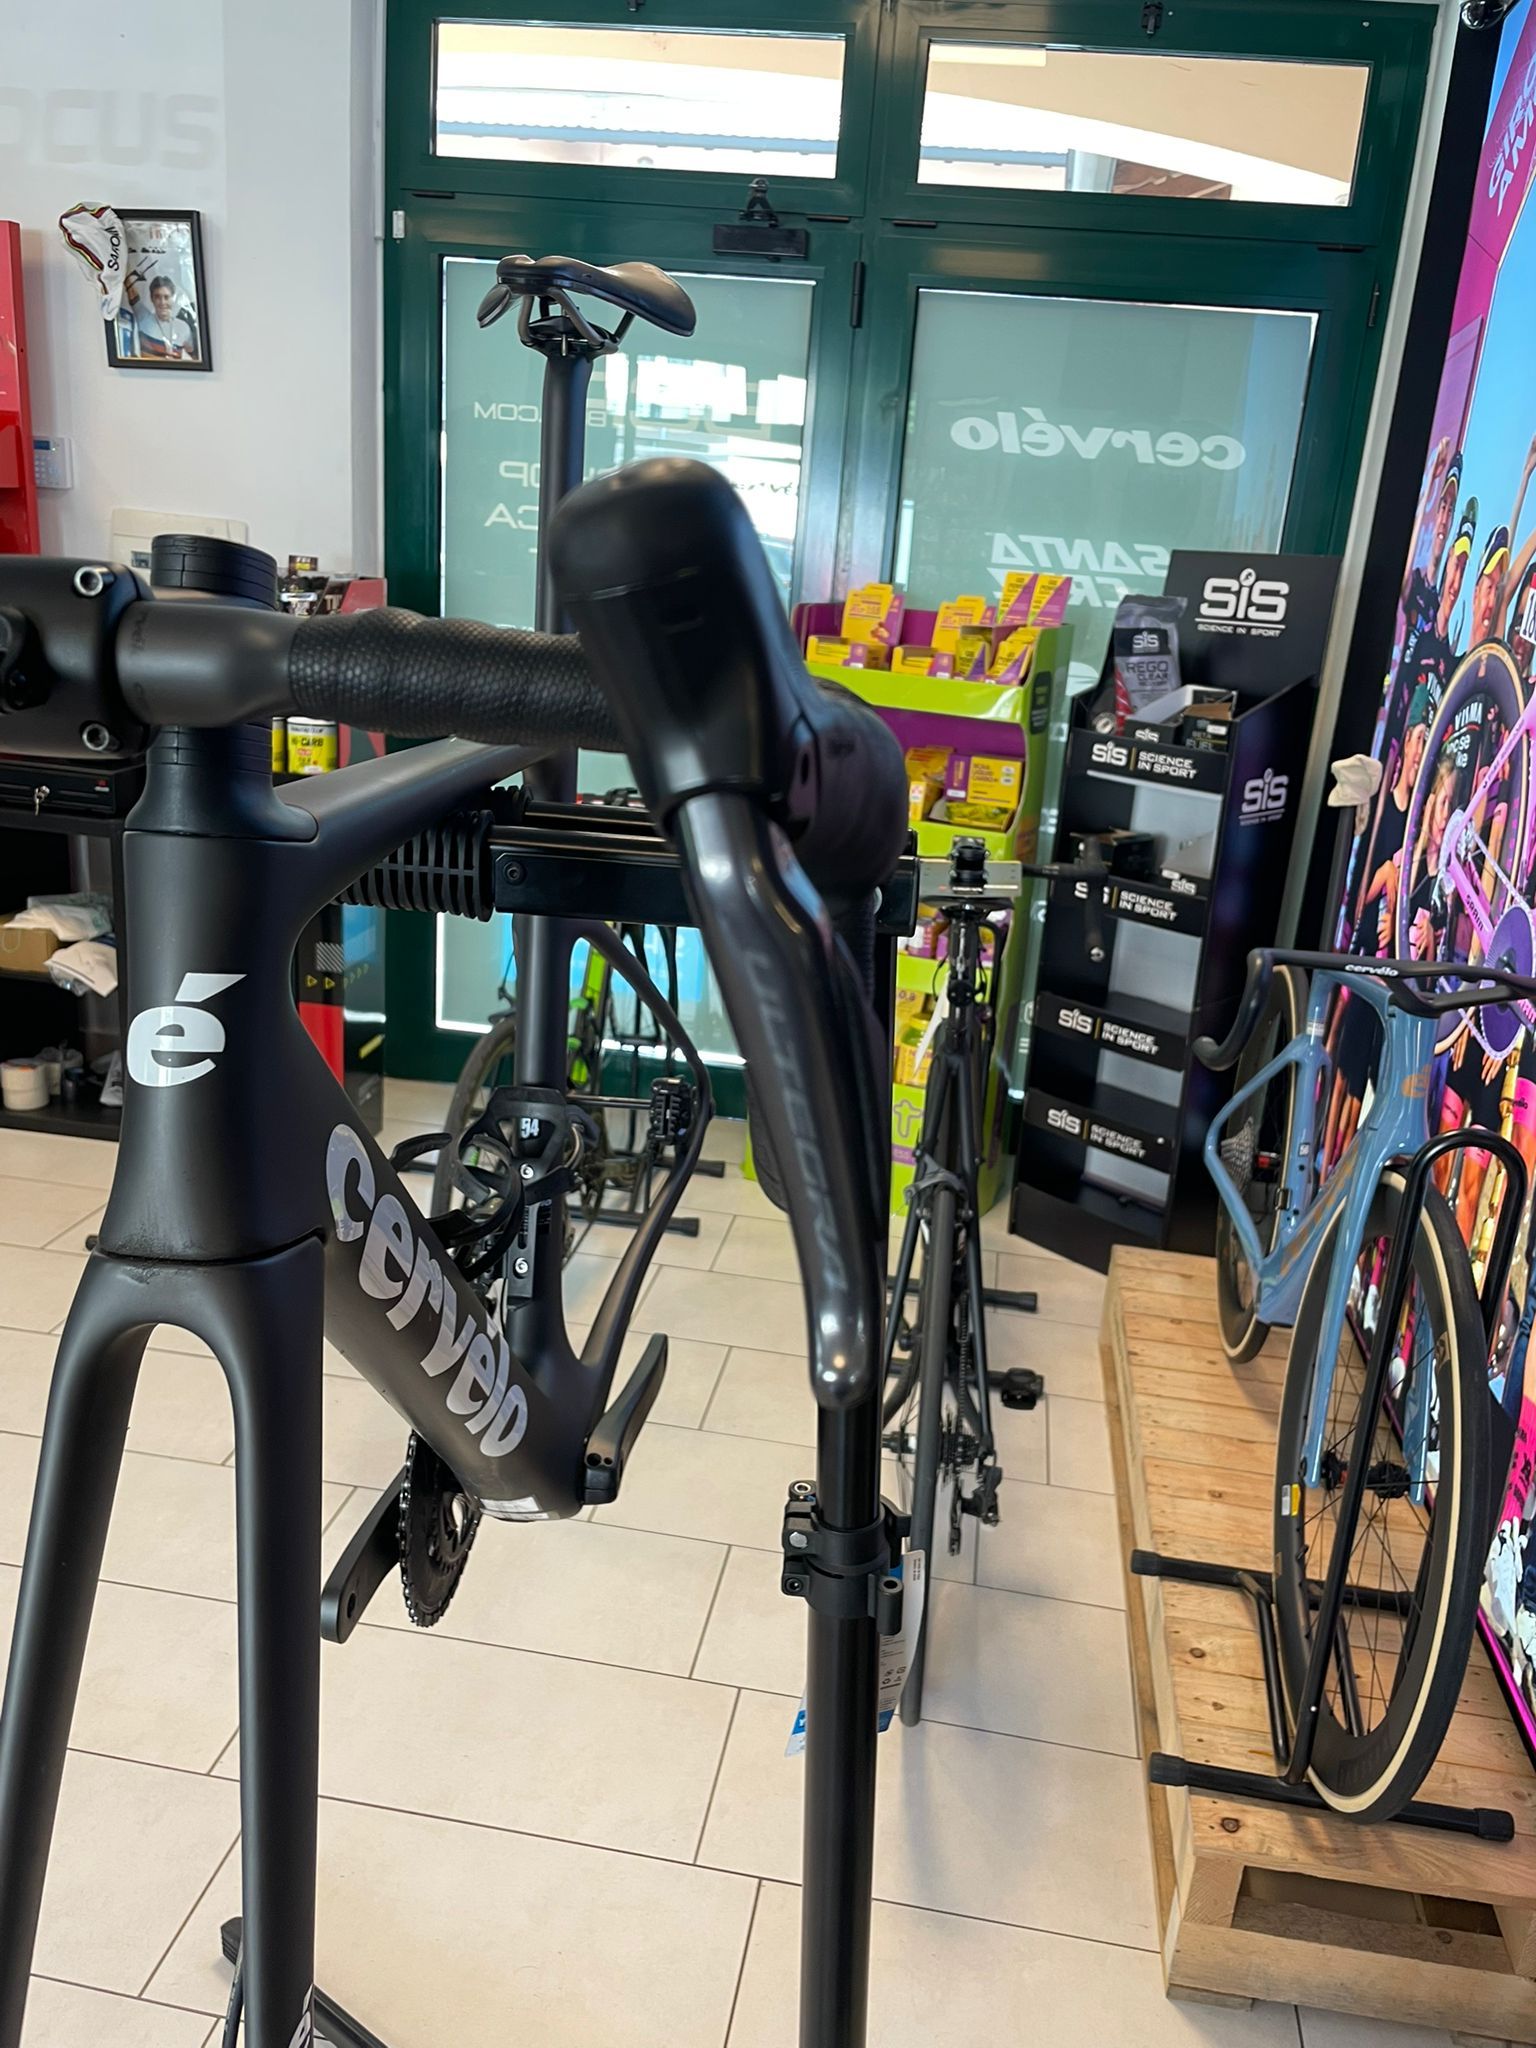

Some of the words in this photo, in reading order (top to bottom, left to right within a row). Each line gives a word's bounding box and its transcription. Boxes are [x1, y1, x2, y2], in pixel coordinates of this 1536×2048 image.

[1197, 623, 1234, 634] SCIENCE
[1236, 626, 1247, 635] IN
[1250, 628, 1282, 638] SPORT
[1126, 660, 1169, 673] REGO
[1137, 760, 1151, 771] IN
[1153, 763, 1197, 780] SPORT
[1139, 751, 1193, 769] SCIENCE
[1119, 900, 1132, 911] IN
[1133, 903, 1178, 921] SPORT
[1120, 890, 1173, 911] SCIENCE
[126, 972, 248, 1088] é
[1102, 1022, 1155, 1044] SCIENCE
[1101, 1032, 1115, 1042] IN
[1116, 1036, 1159, 1055] SPORT
[520, 1117, 539, 1139] 54
[1091, 1123, 1143, 1148] SCIENCE
[1090, 1134, 1103, 1144] IN
[1105, 1138, 1146, 1159] SPORT
[325, 1123, 528, 1457] cervélo
